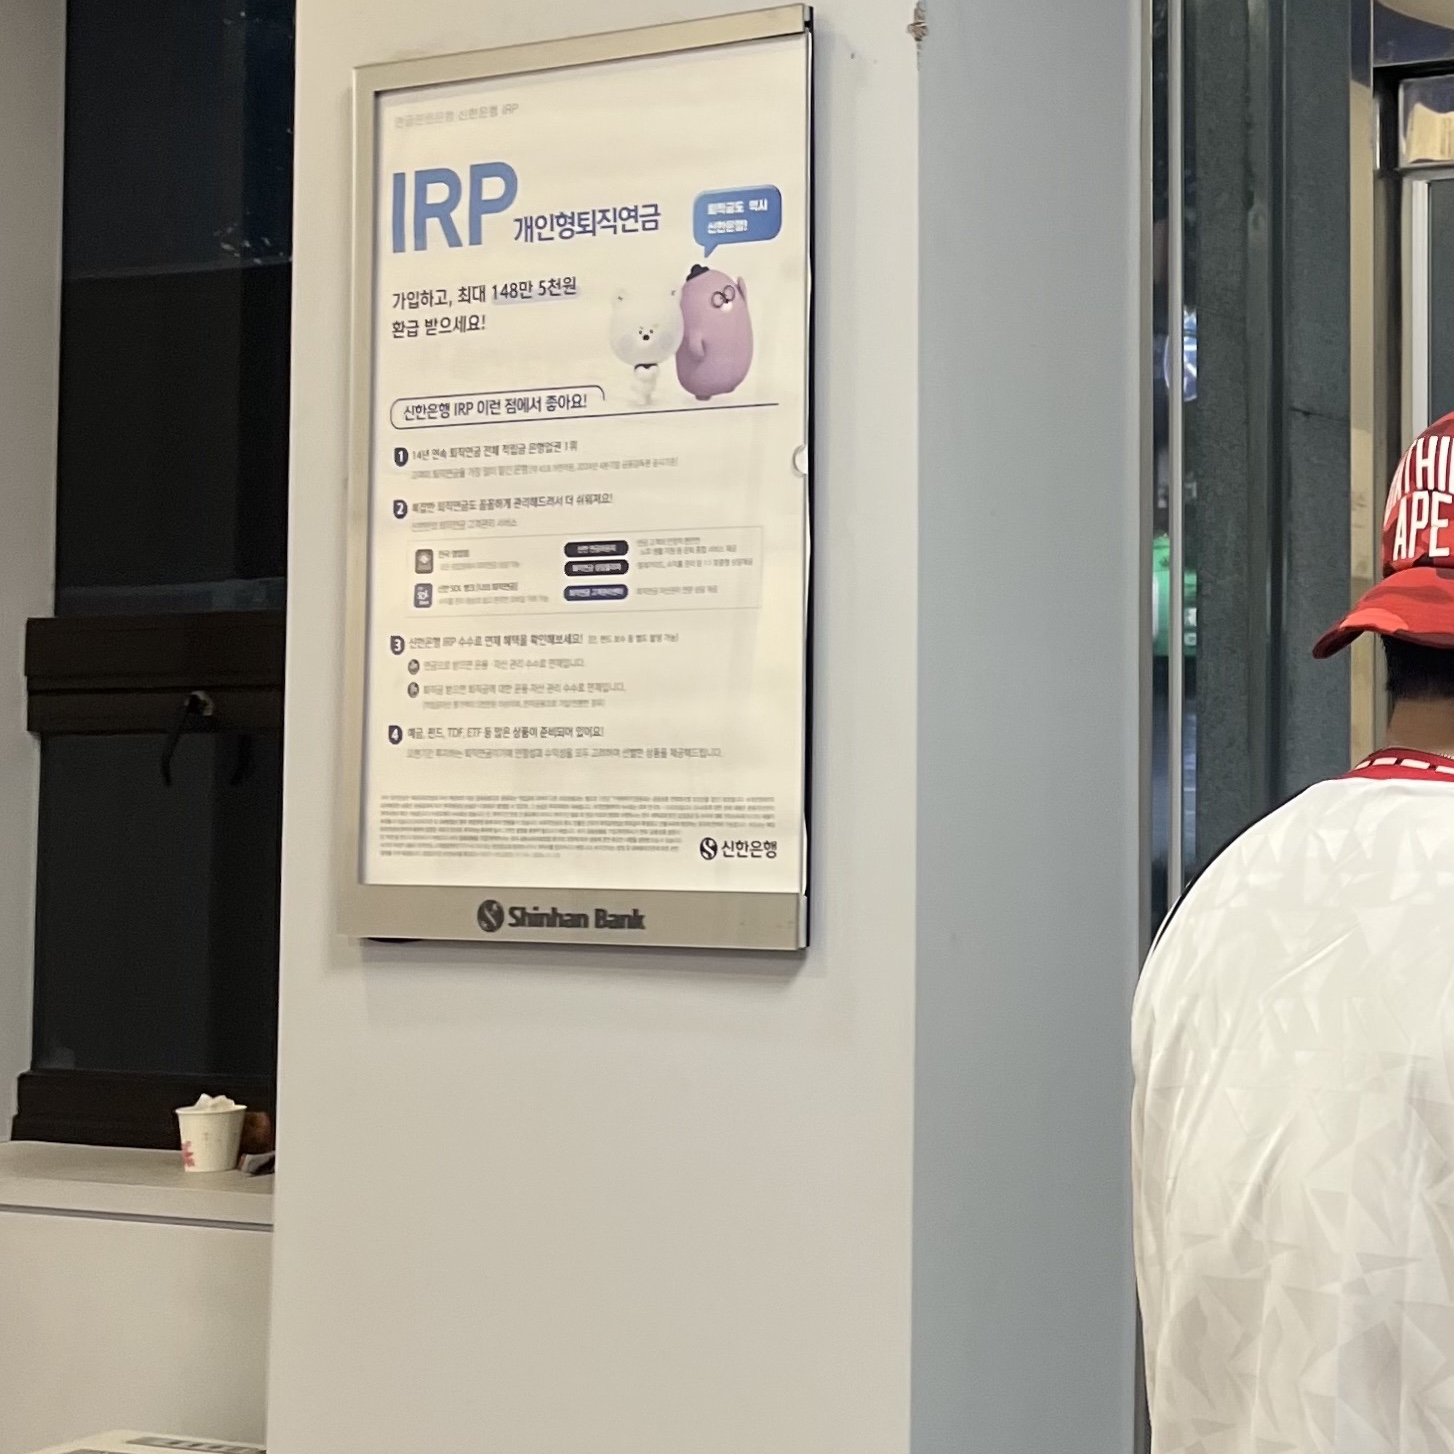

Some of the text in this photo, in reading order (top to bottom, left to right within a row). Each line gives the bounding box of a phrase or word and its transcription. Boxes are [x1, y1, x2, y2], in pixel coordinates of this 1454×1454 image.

[393, 162, 518, 253] IRP
[513, 203, 661, 243] 개인형퇴직연금
[392, 276, 577, 310] 가입하고, 최대 148만 5천원
[392, 314, 486, 339] 환급 받으세요!
[404, 393, 587, 422] 신한은행 IRP 이런 점에서 좋아요!
[1393, 490, 1453, 561] APE
[721, 840, 778, 859] 신한은행
[508, 905, 646, 930] Shinhan Bank
